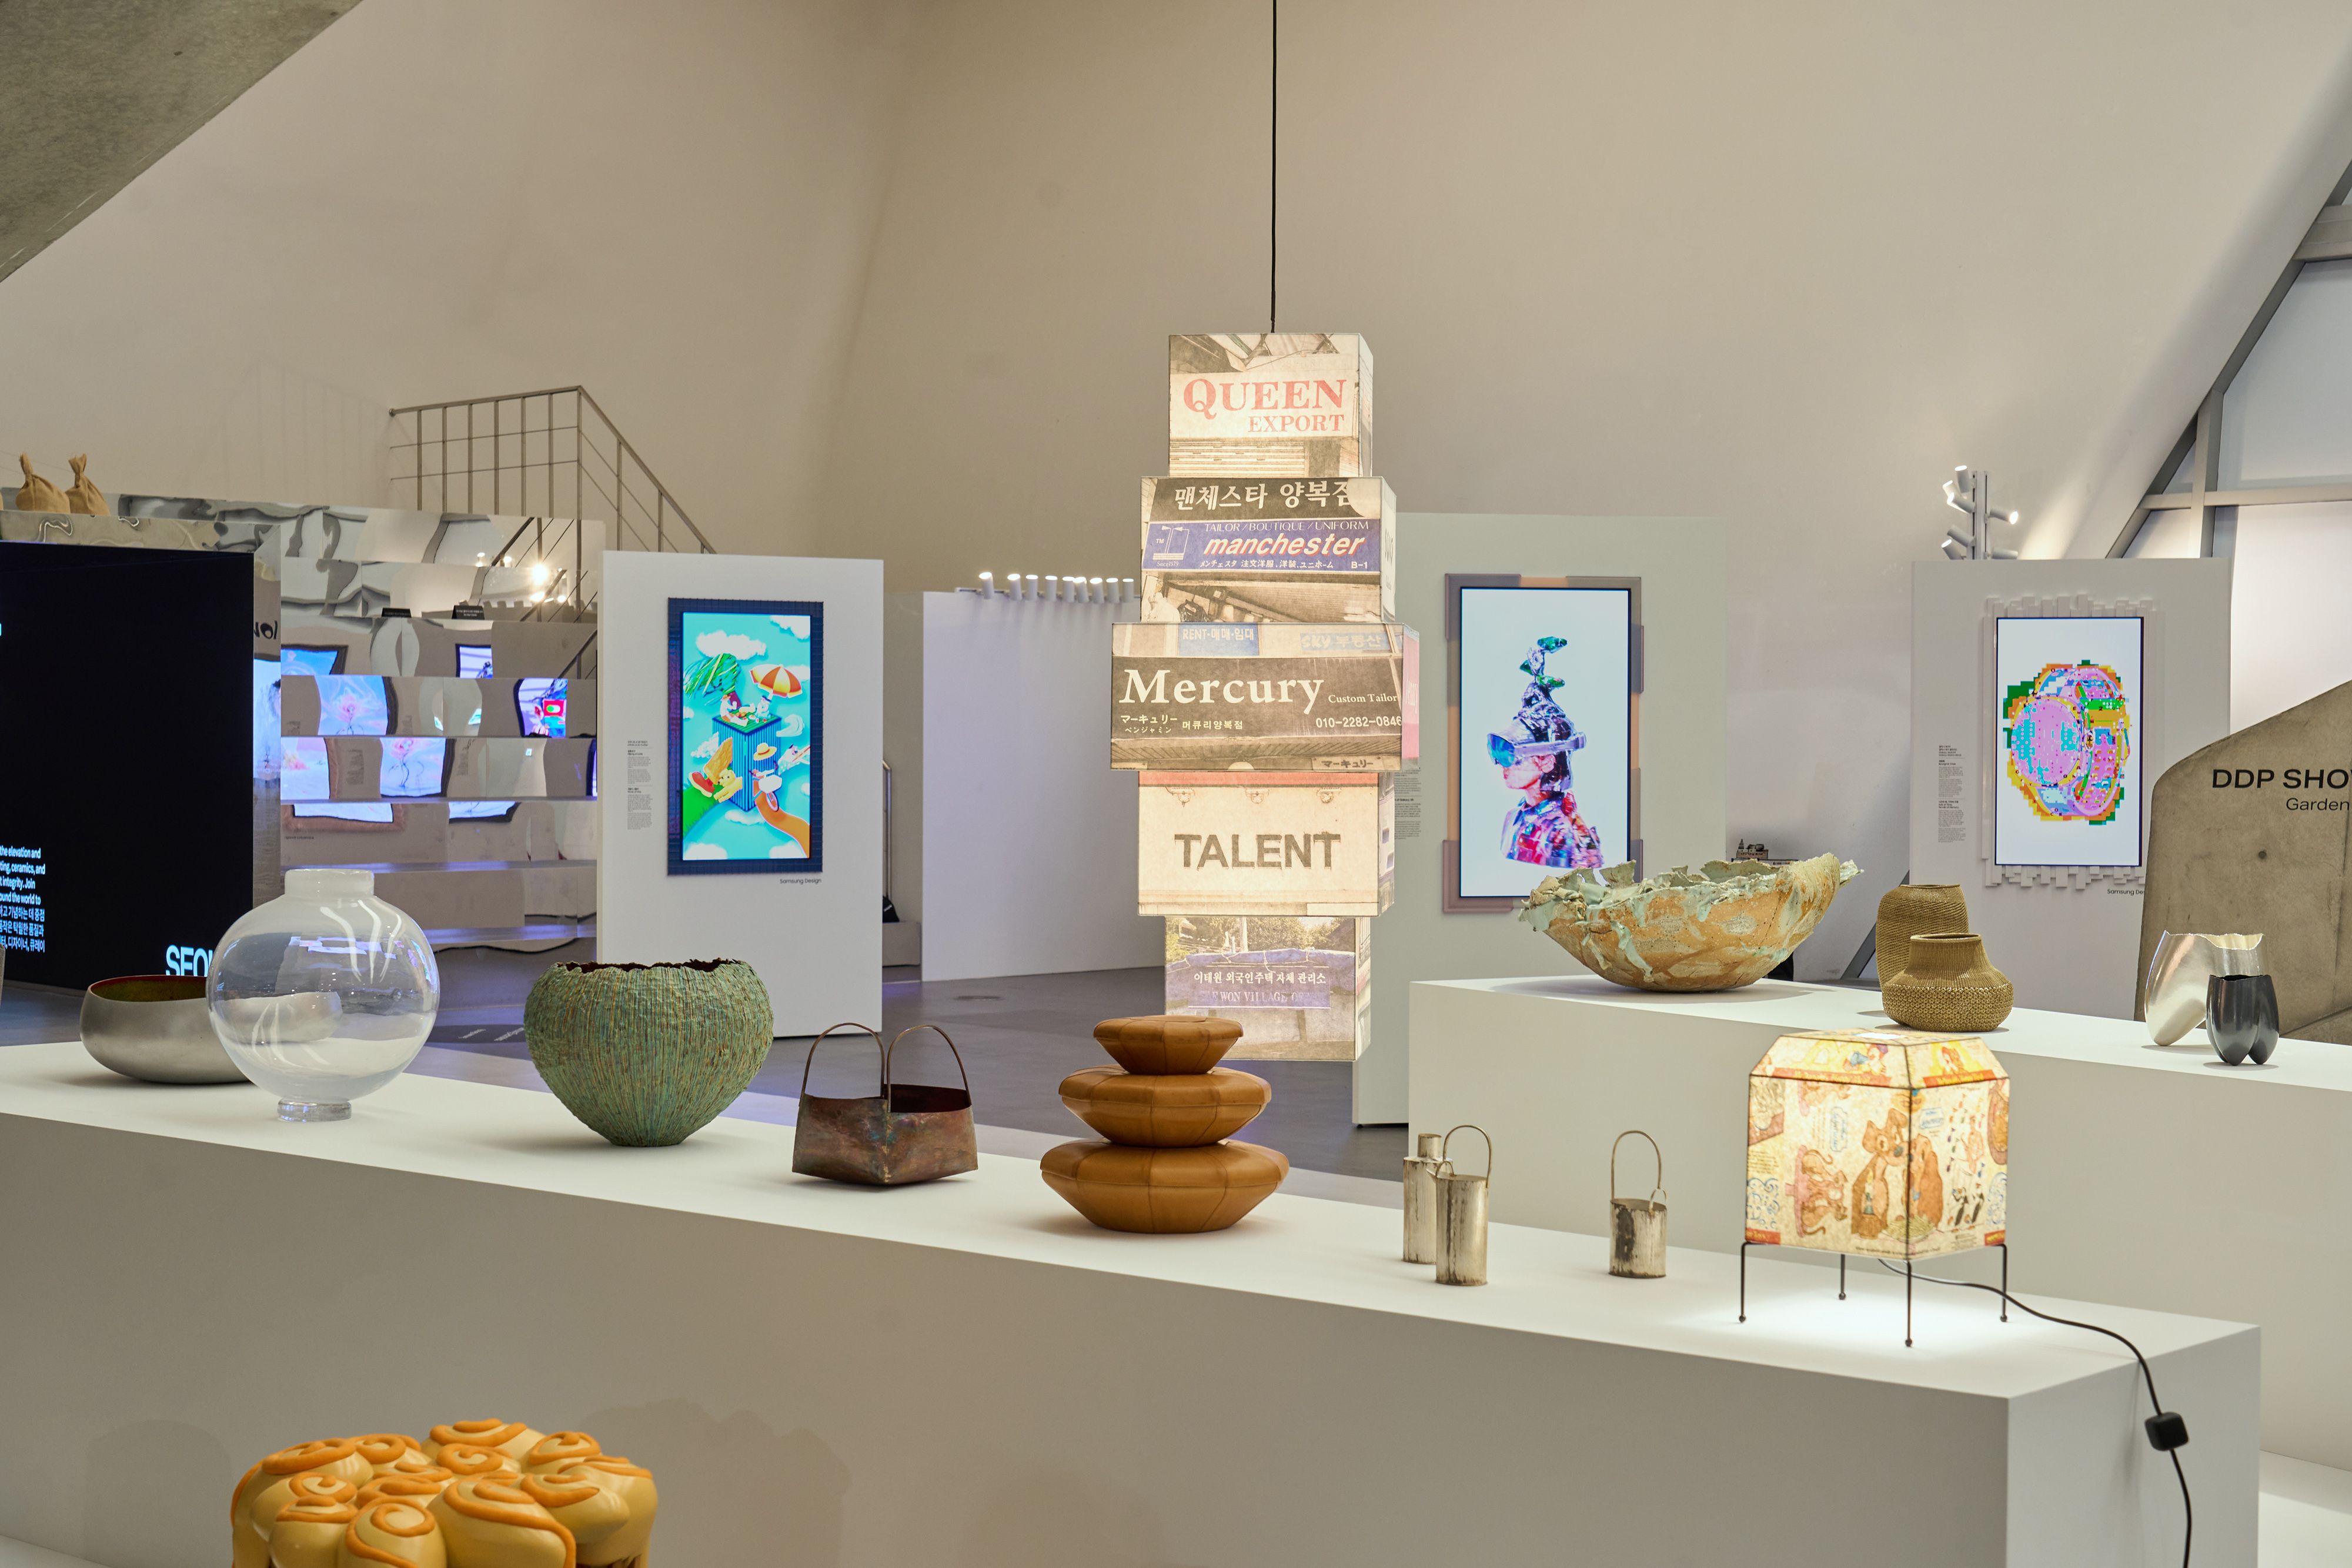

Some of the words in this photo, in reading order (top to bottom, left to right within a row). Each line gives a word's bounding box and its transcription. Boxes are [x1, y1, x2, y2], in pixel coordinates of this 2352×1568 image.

[1183, 379, 1347, 420] QUEEN
[1248, 414, 1345, 433] EXPORT
[1175, 483, 1268, 510] 맨체스타
[1204, 533, 1366, 557] manchester
[1336, 634, 1382, 648] 부동산
[1119, 669, 1324, 715] Mercury
[1328, 694, 1366, 703] Custom
[1367, 693, 1398, 702] Tailor
[1120, 714, 1178, 724] マーキュリー
[1182, 720, 1243, 730] 머큐리양복점
[1315, 716, 1402, 728] 010-2282-0846
[1321, 759, 1374, 768] マーキュリー
[2212, 769, 2274, 789] DDP
[2283, 768, 2352, 789] SHO
[2286, 798, 2350, 811] Garden
[8, 845, 31, 858] elevation
[31, 847, 41, 859] and
[1174, 831, 1341, 870] TALENT
[11, 862, 35, 876] ceramics,
[35, 863, 46, 875] and
[24, 877, 35, 889] Join
[12, 891, 20, 903] the
[21, 893, 35, 905] world
[35, 893, 41, 905] to
[8, 905, 28, 920] 기념하는
[35, 908, 45, 922] 중점
[13, 921, 28, 935] 탁월한
[29, 922, 44, 937] 품질과
[29, 938, 45, 953] 큐레이
[1194, 971, 1222, 984] 이태원
[1276, 972, 1294, 984] 자체
[1297, 972, 1327, 985] 관리소
